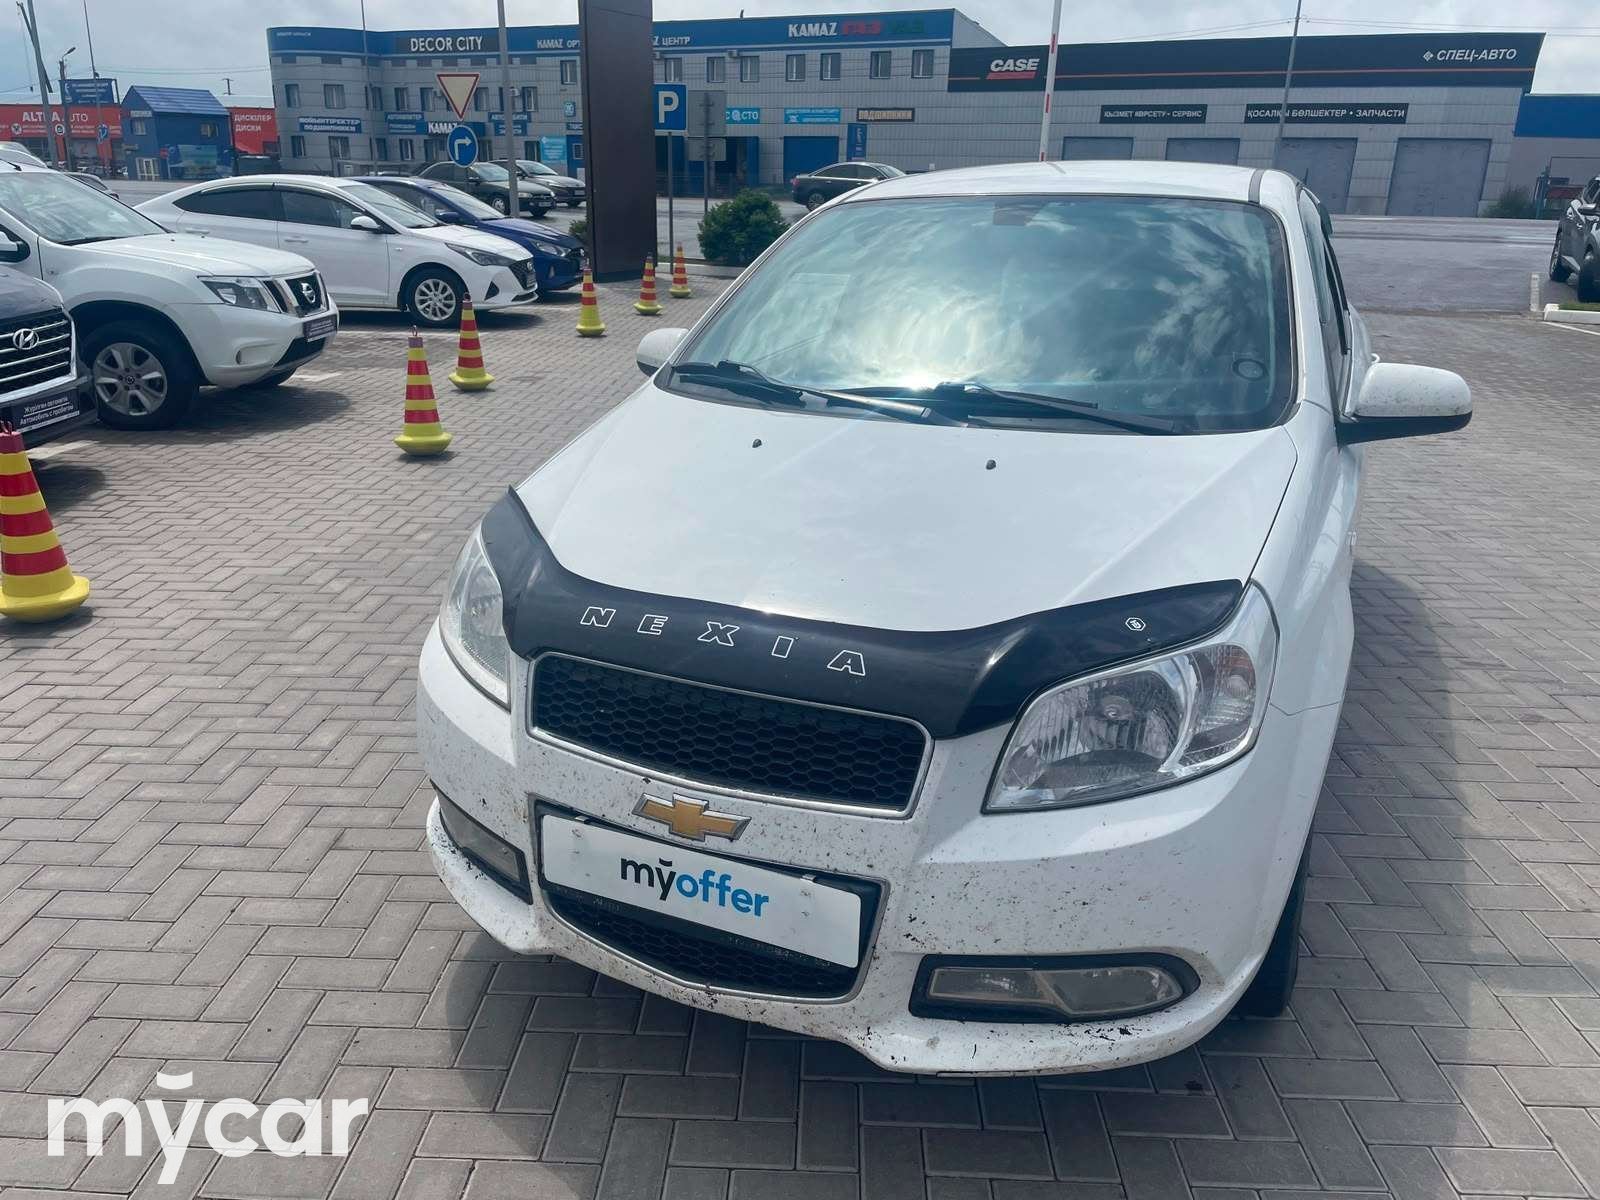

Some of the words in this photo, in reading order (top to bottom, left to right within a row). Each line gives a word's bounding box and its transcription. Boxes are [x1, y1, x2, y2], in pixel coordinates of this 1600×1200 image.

[788, 22, 838, 37] KAMAZ
[410, 37, 452, 51] DECOR
[456, 36, 482, 51] CITY
[1436, 49, 1517, 62] СПЕЦ-АВТО
[990, 58, 1040, 72] CASE
[658, 91, 679, 123] P
[1355, 109, 1405, 117] ЗАПЧАСТИ
[580, 606, 866, 677] NEXIA
